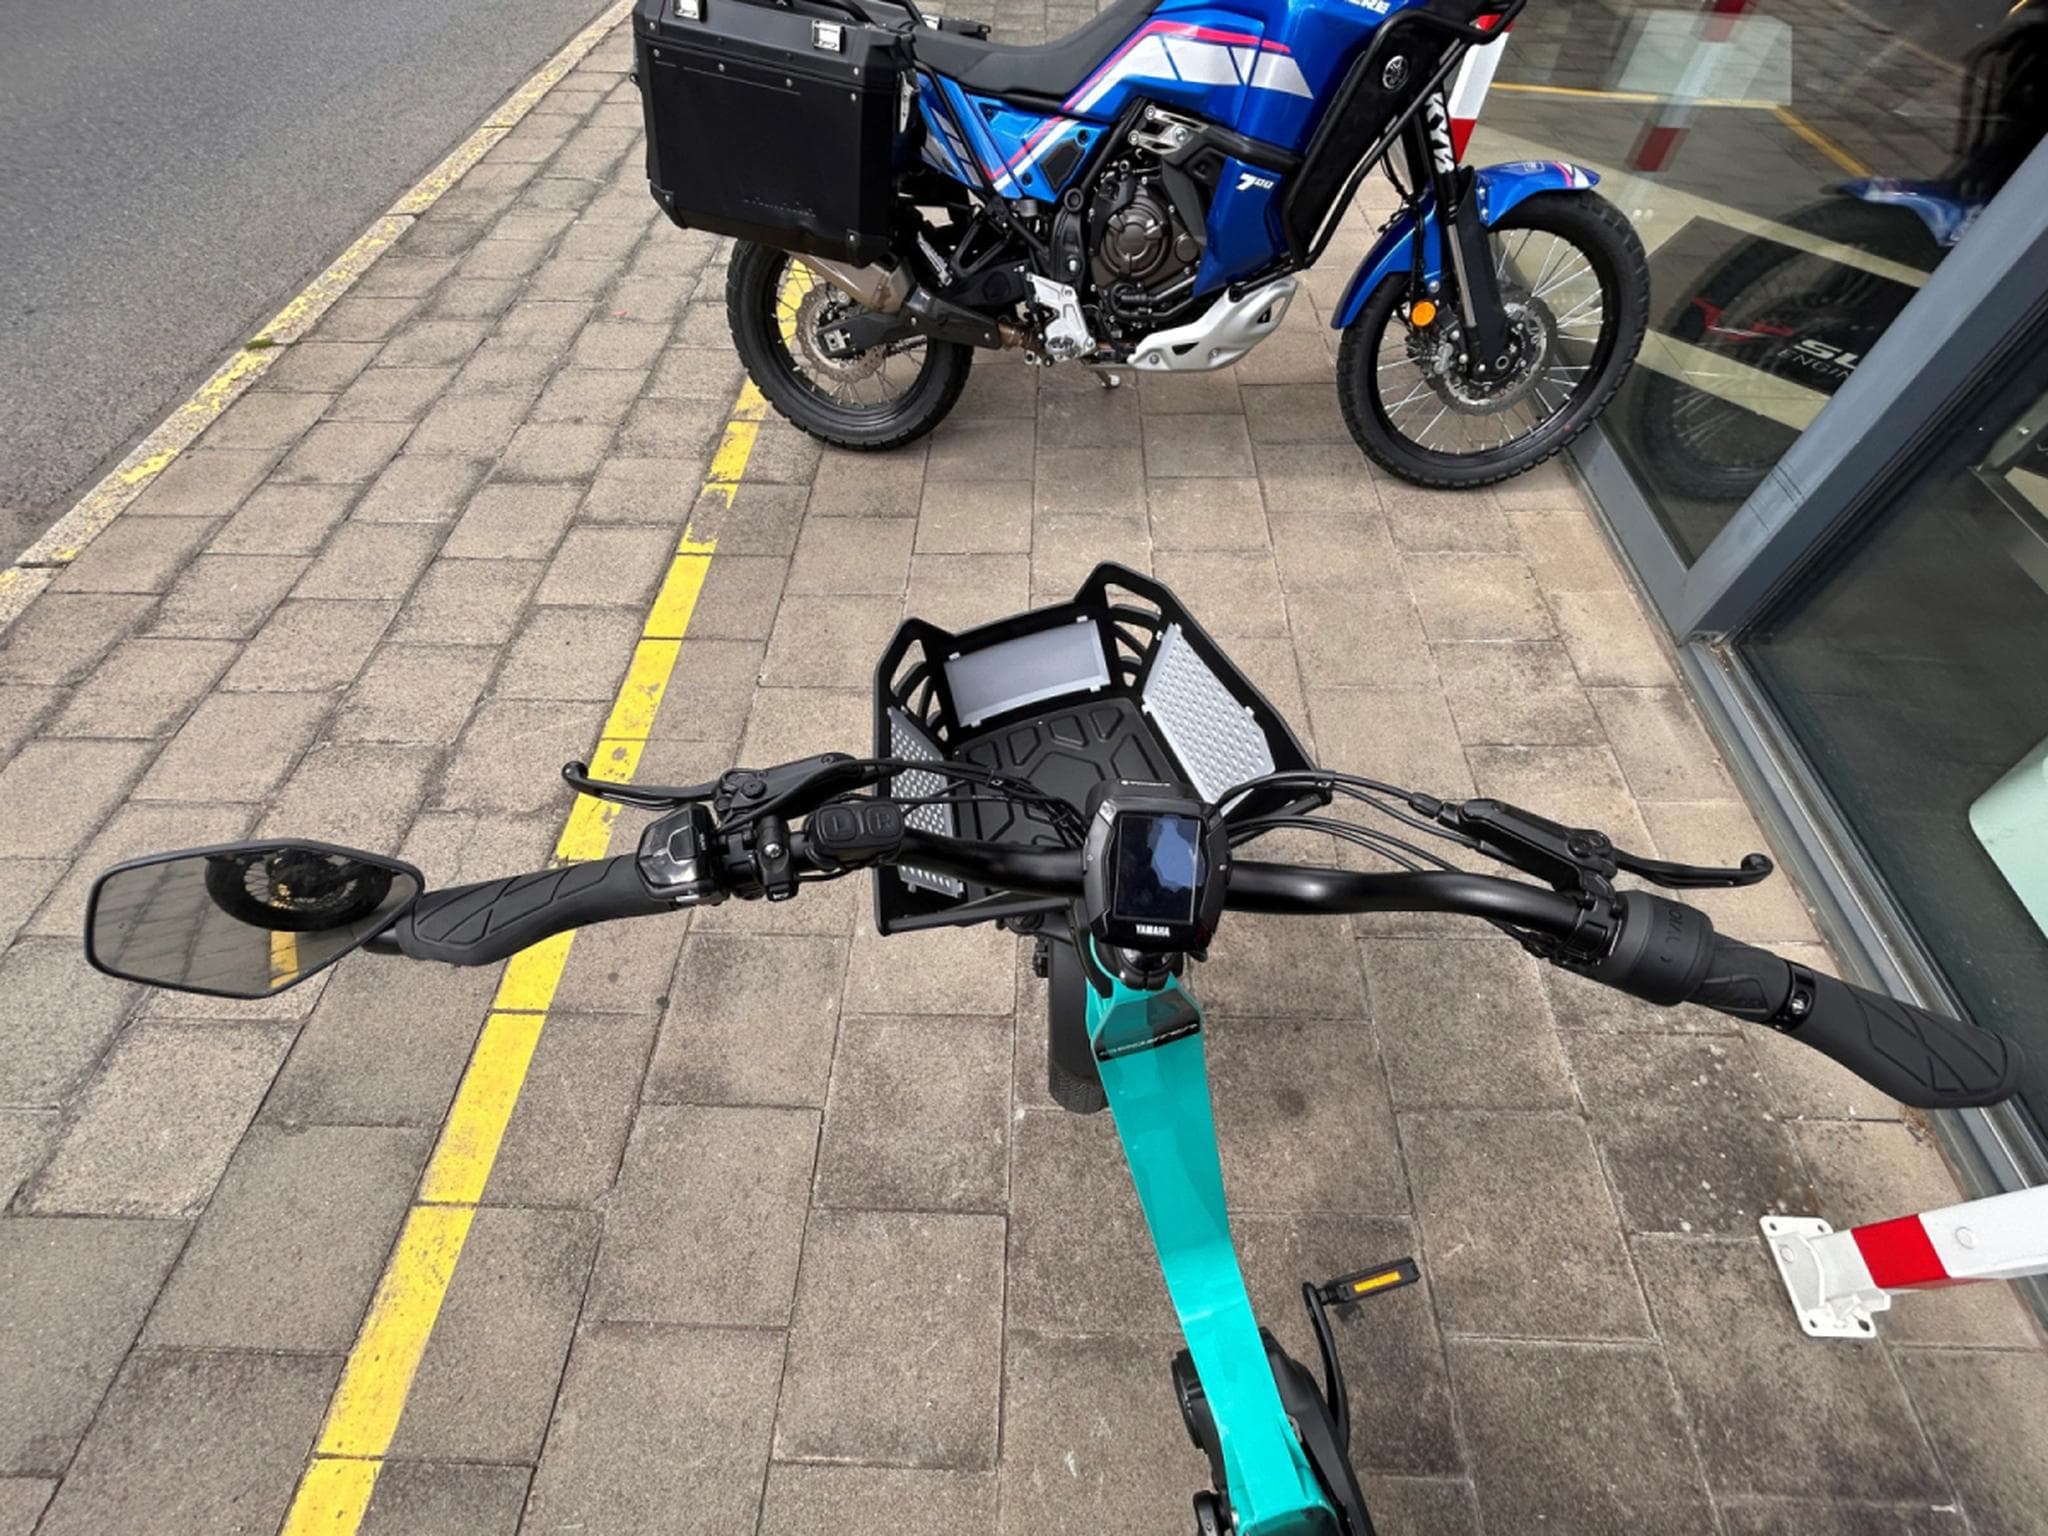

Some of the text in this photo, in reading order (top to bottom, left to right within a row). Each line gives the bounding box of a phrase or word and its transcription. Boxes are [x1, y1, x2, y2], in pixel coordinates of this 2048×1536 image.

[1424, 91, 1455, 174] KYB
[1236, 173, 1274, 190] 700
[1136, 924, 1170, 937] YAMAHA
